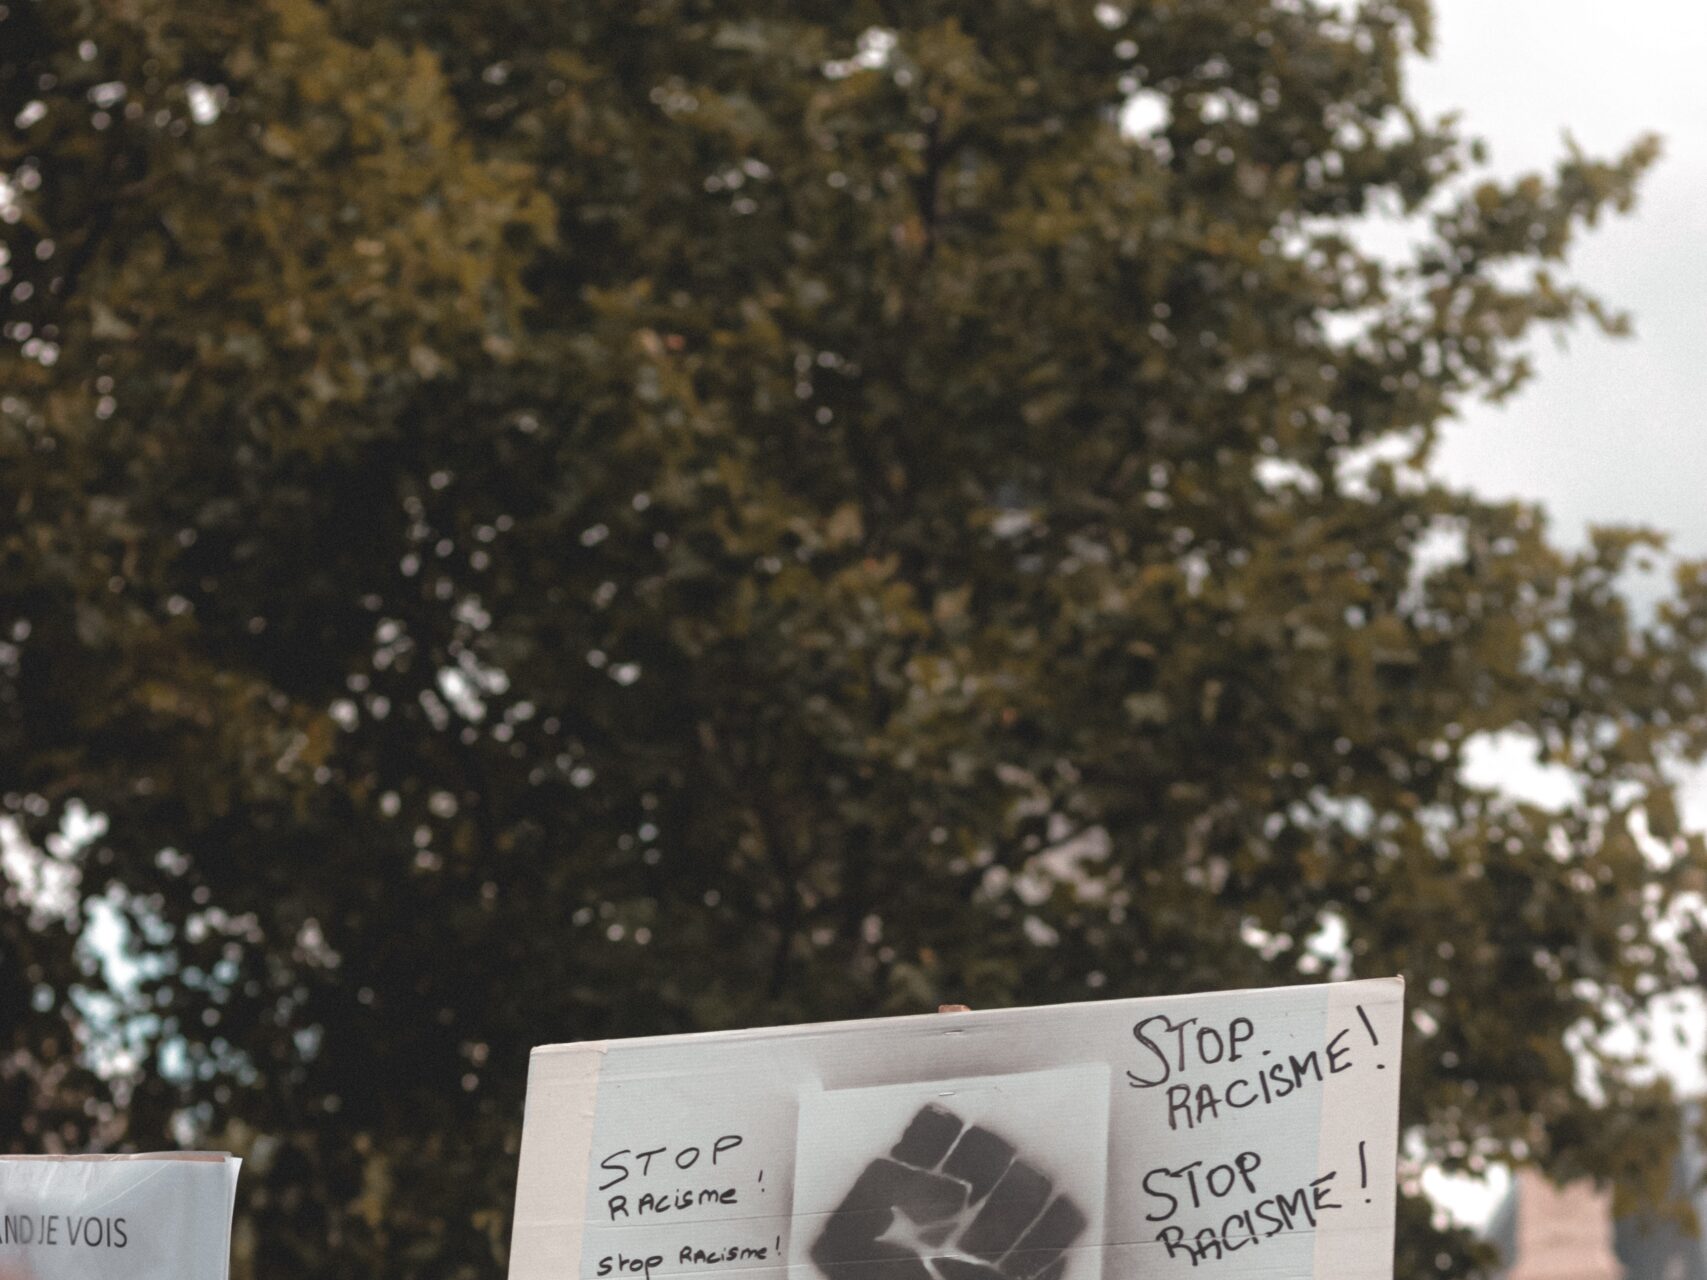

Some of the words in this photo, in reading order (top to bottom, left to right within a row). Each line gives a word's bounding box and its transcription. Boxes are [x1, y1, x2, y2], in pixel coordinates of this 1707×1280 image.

[598, 1134, 744, 1191] STOP
[1141, 1150, 1262, 1222] STOP
[37, 1214, 60, 1246] JE
[65, 1215, 128, 1249] VOIS
